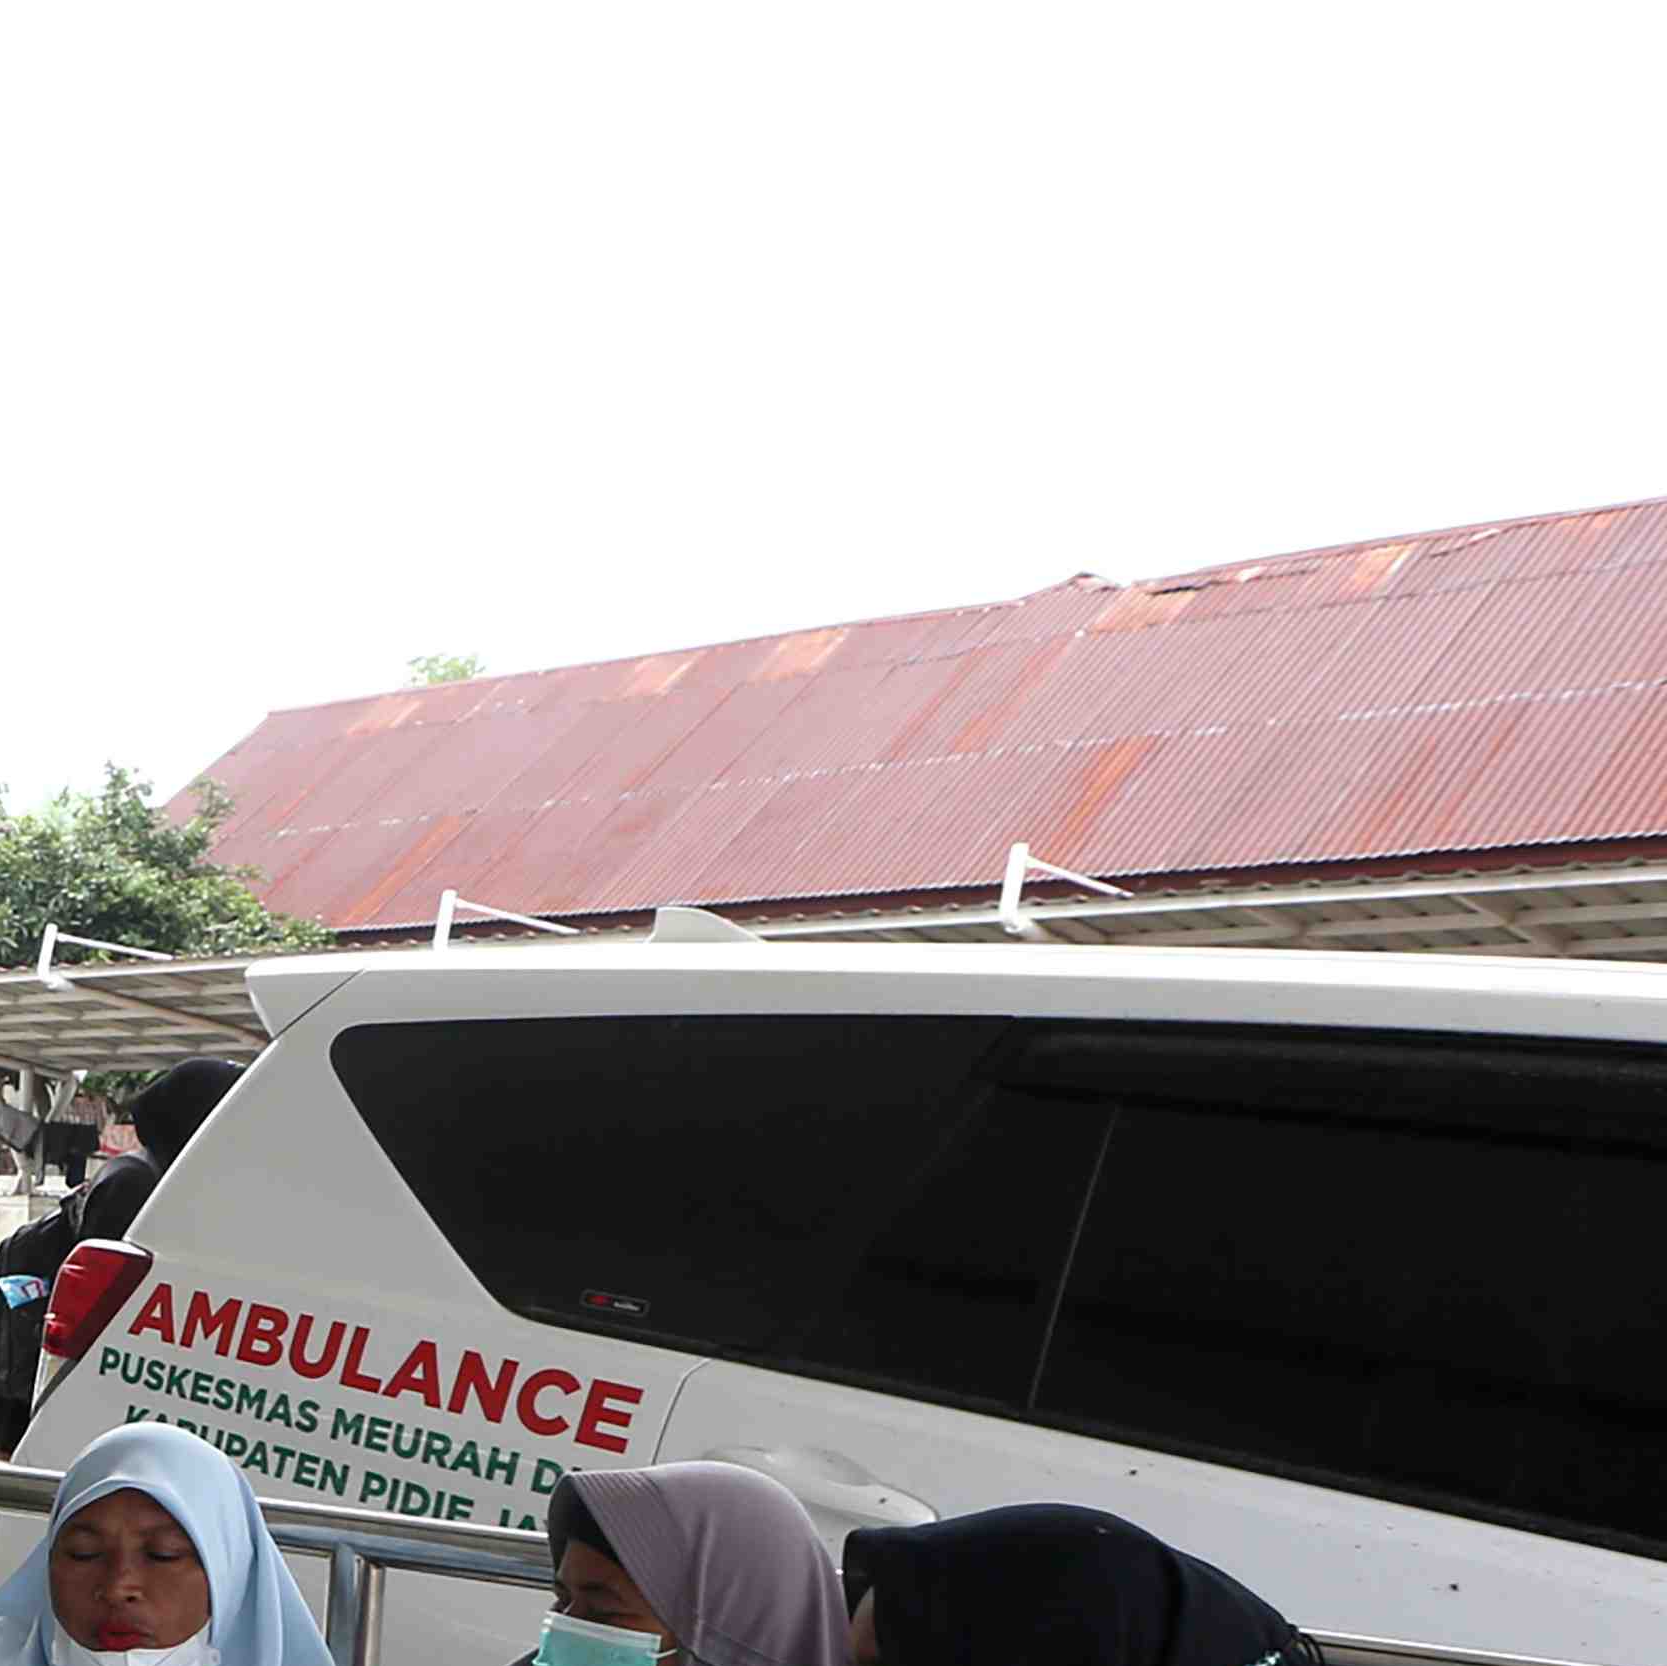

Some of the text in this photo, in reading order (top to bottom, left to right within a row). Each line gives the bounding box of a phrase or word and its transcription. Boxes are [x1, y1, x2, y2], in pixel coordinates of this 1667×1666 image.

[99, 1347, 319, 1433] PUSKESMAS
[330, 1409, 520, 1486] MEURAH
[128, 1282, 644, 1453] AMBULANCE
[359, 1472, 474, 1518] PIDIE
